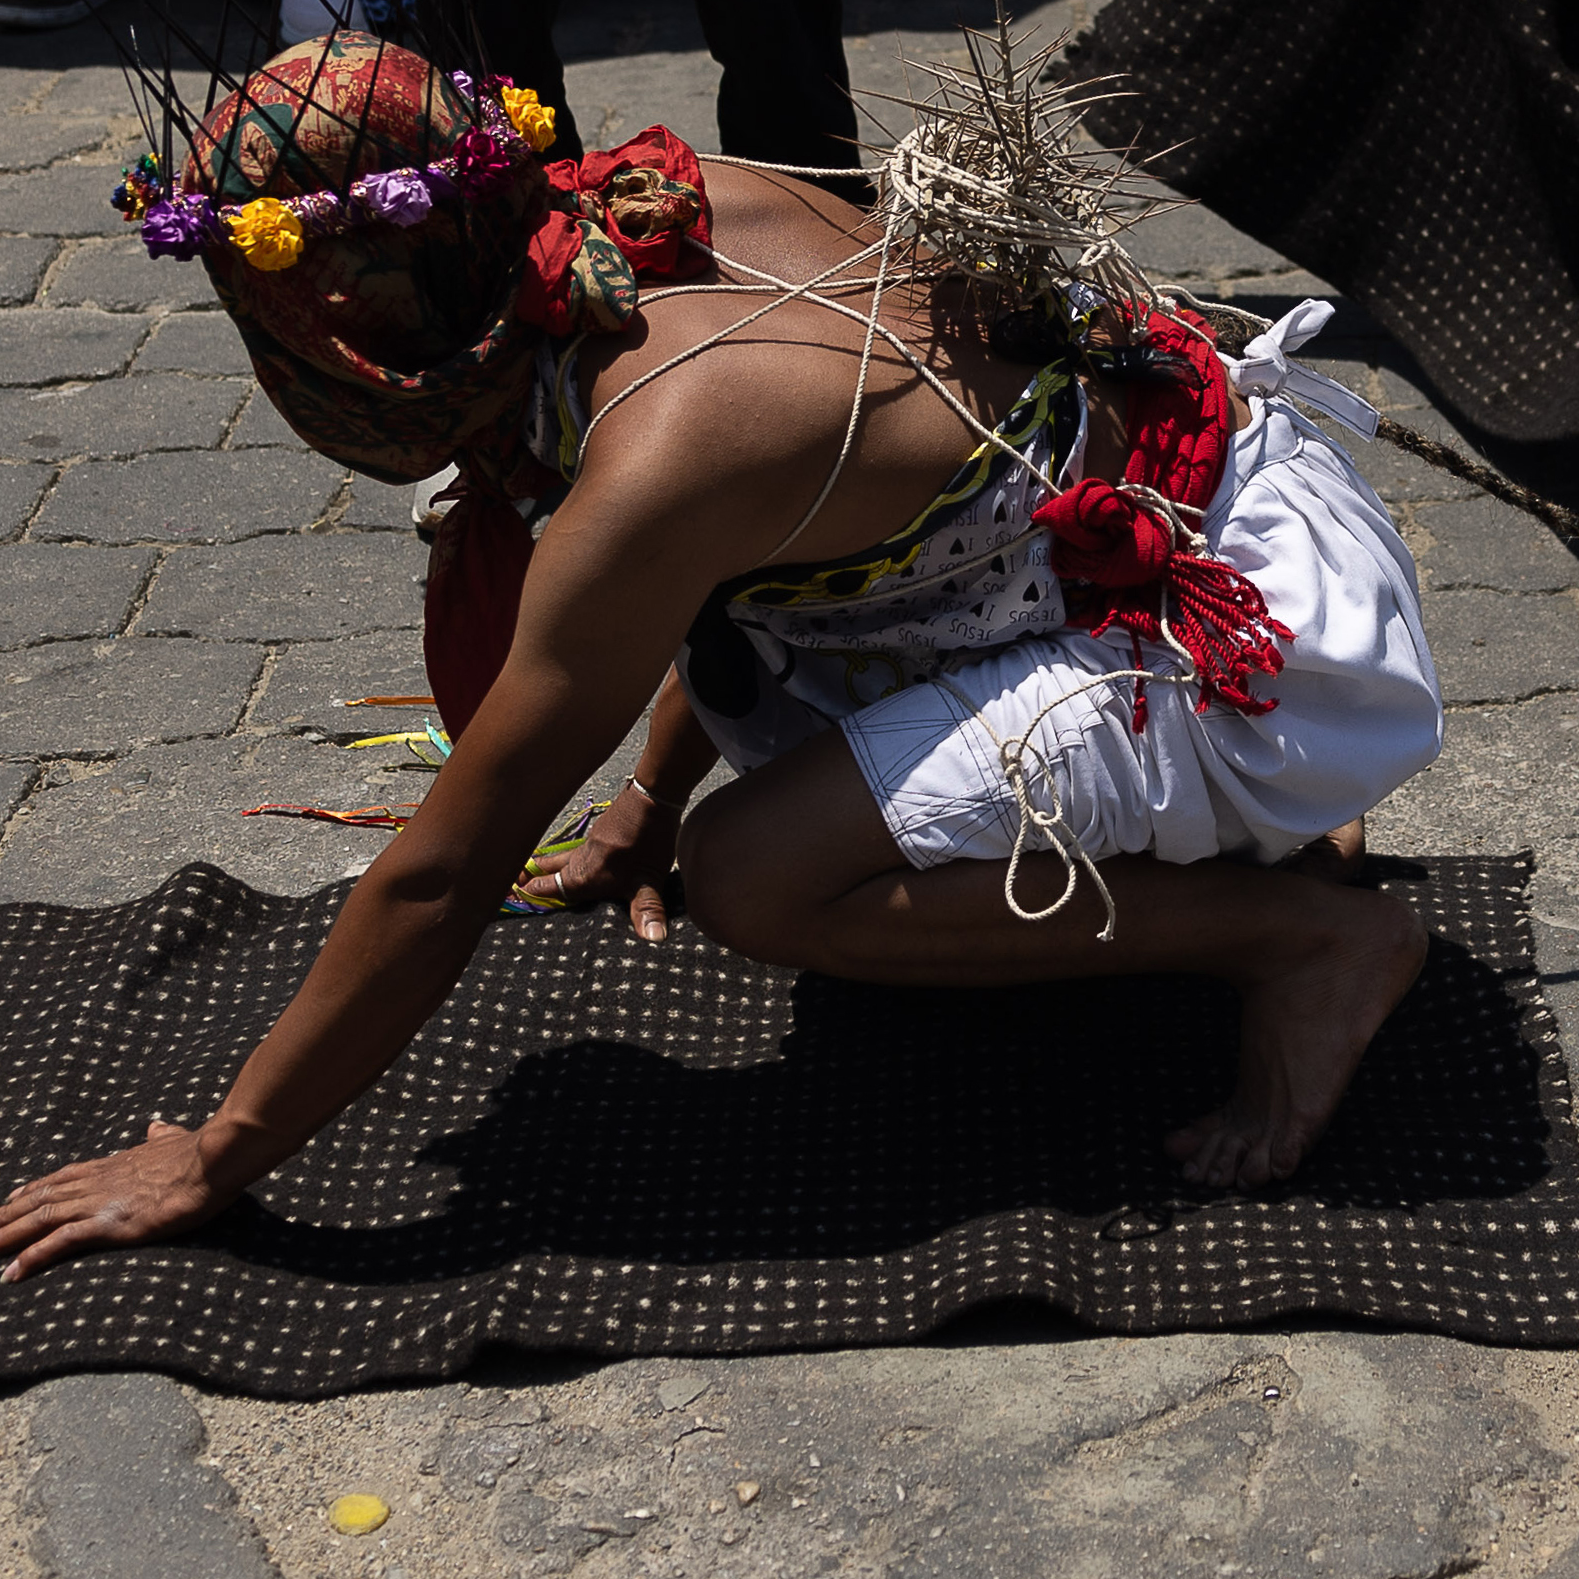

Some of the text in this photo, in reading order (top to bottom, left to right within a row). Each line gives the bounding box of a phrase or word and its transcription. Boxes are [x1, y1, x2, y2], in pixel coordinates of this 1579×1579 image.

[1008, 606, 1057, 623] JESUS
[897, 627, 938, 648] JESUS
[949, 618, 995, 642] JESUS
